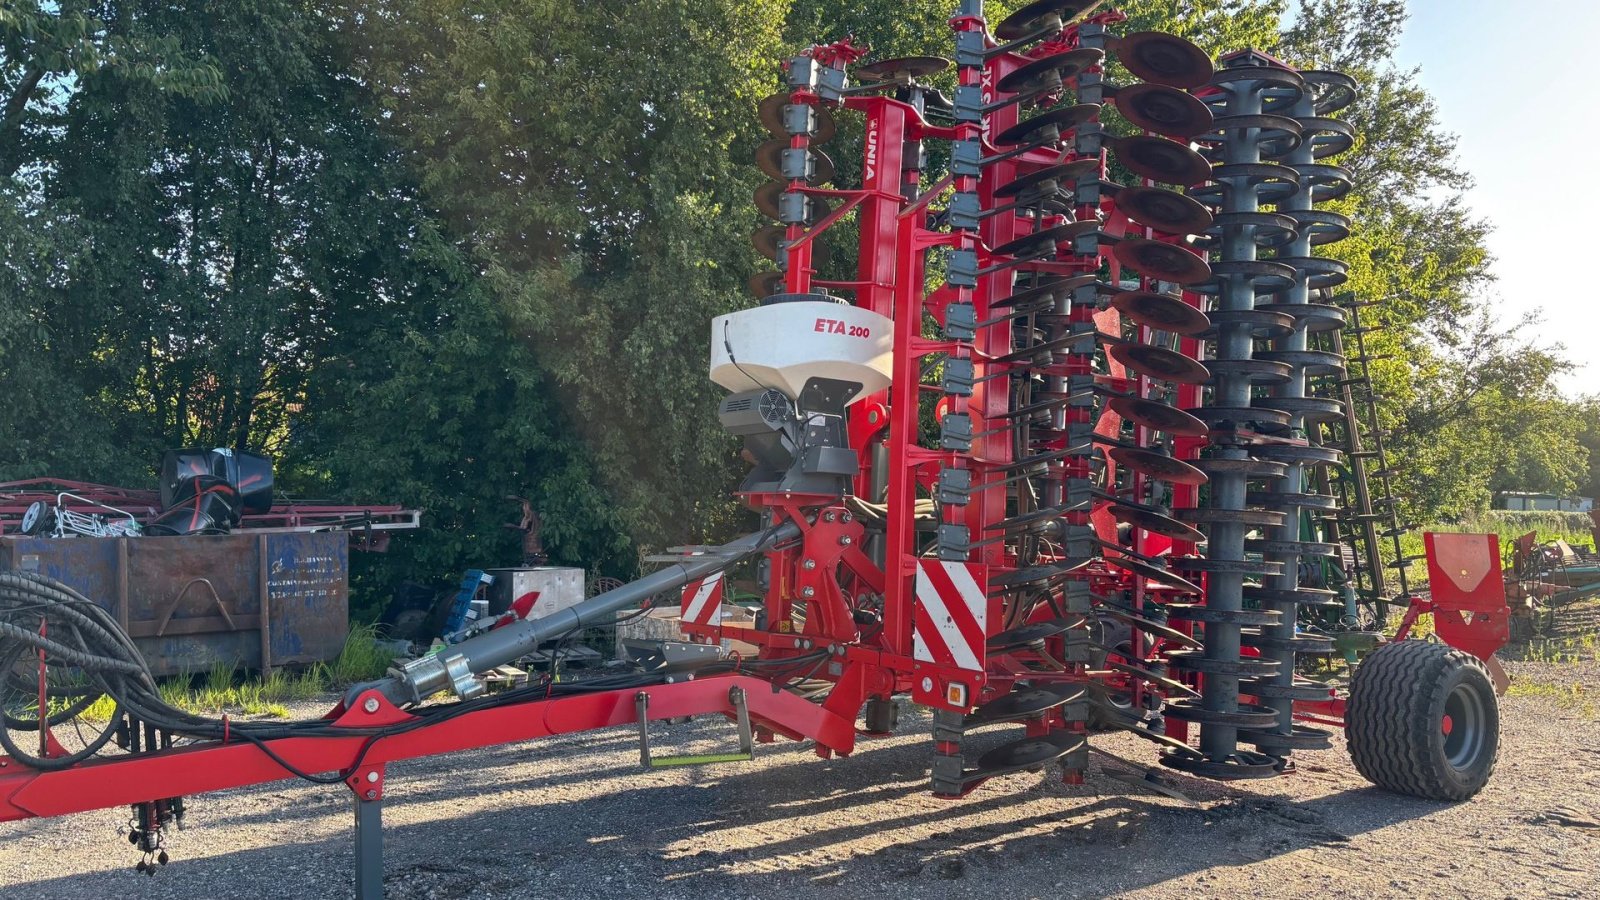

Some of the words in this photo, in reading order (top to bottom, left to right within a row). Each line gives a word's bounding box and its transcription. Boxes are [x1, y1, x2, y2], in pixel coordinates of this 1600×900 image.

[866, 130, 877, 180] UNIA
[814, 318, 846, 335] ETA
[848, 325, 870, 339] 200
